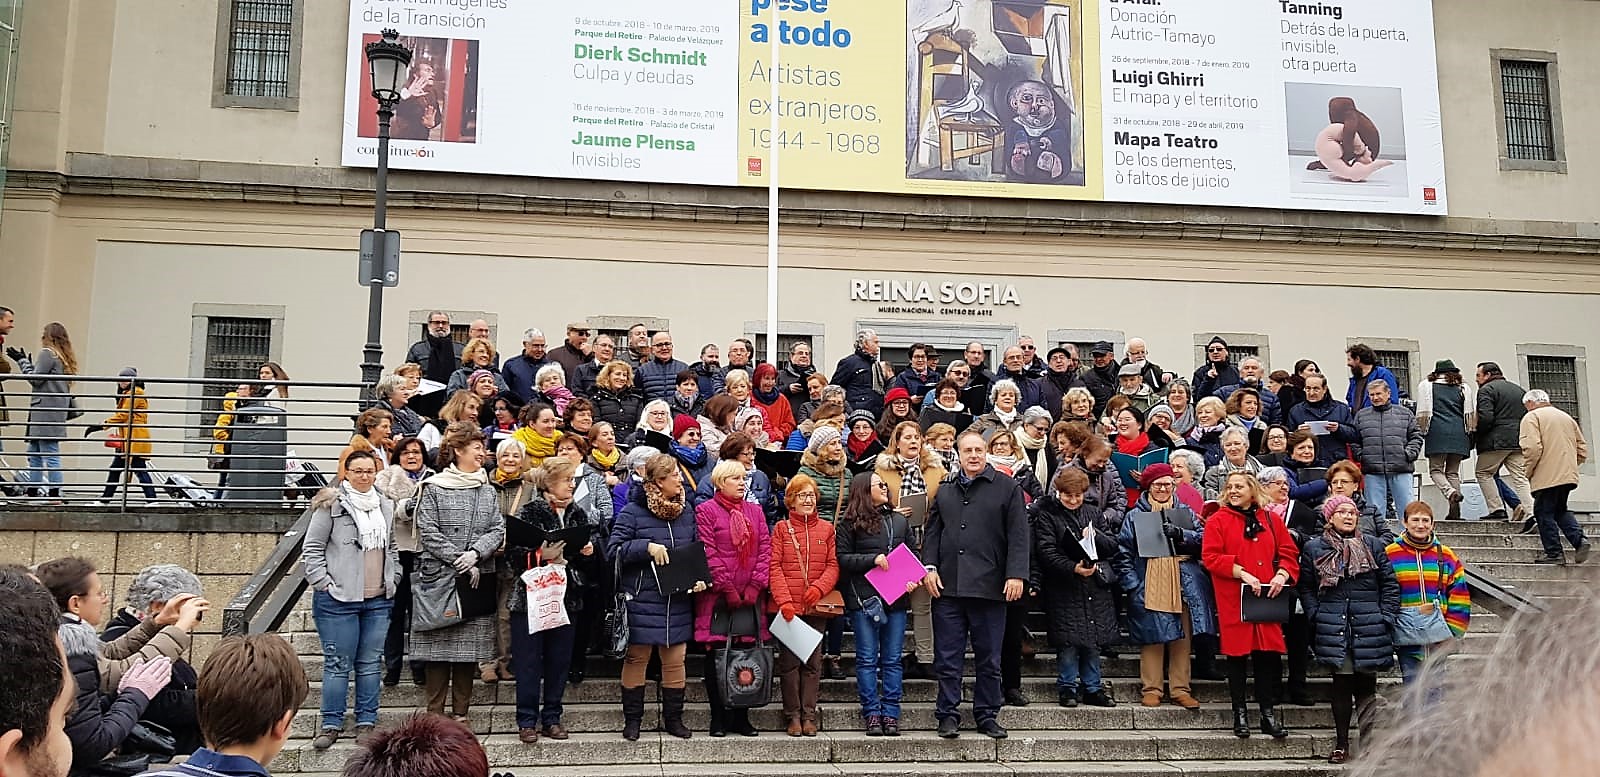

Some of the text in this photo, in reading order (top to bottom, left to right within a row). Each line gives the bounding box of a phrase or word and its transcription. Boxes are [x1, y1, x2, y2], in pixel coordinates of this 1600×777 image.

[363, 6, 486, 28] de la Transición
[1110, 7, 1177, 24] Donación
[1279, 0, 1342, 19] Tanning
[575, 17, 580, 25] 9
[582, 18, 591, 26] de
[624, 20, 645, 29] 2018
[652, 22, 662, 30] 10
[664, 23, 673, 31] de
[700, 25, 720, 34] 2019
[750, 20, 852, 48] a todo
[1281, 19, 1409, 42] Detrás de la puerta,
[574, 29, 604, 39] Parque
[605, 30, 617, 38] del
[618, 31, 643, 40] Retiro
[649, 33, 676, 42] Palacio
[676, 35, 686, 43] de
[687, 36, 724, 46] Velázquez
[1110, 25, 1216, 47] Autric-Tamayo
[574, 44, 707, 66] Dierk Schmidt
[1281, 38, 1339, 55] invisible,
[1111, 55, 1121, 63] 26
[1122, 55, 1131, 63] de
[1132, 56, 1171, 66] septiembre,
[1171, 58, 1190, 66] 2018
[1232, 61, 1250, 69] 2019
[1282, 57, 1357, 75] otra puerta
[573, 63, 694, 86] Culpa y deudas
[750, 59, 841, 87] Artistas
[1112, 69, 1204, 88] Luigi Ghirri
[1113, 87, 1259, 109] El mapa y el territorio
[583, 103, 593, 111] de
[634, 106, 655, 115] 2018
[669, 108, 678, 116] de
[704, 110, 724, 119] 2019
[749, 95, 881, 124] extranjeros,
[572, 115, 602, 125] Parque
[604, 117, 617, 125] del
[618, 118, 644, 127] Retiro
[650, 120, 678, 129] Palacio
[690, 122, 715, 131] Cristal
[1113, 117, 1121, 125] 31
[1123, 117, 1132, 125] de
[1161, 119, 1180, 127] 2018
[1187, 120, 1198, 128] 29
[1225, 122, 1244, 130] 2019
[572, 131, 696, 151] Jaume Plensa
[749, 128, 804, 150] 1944
[826, 132, 880, 154] 1968
[1114, 131, 1218, 150] Mapa Teatro
[572, 151, 641, 169] Invisibles
[1115, 150, 1236, 172] De los dementes,
[1128, 169, 1168, 186] faltos
[1171, 171, 1189, 187] de
[1191, 173, 1230, 190] juicio
[850, 278, 1020, 306] REINA SOFIA
[878, 306, 900, 314] MUSEO
